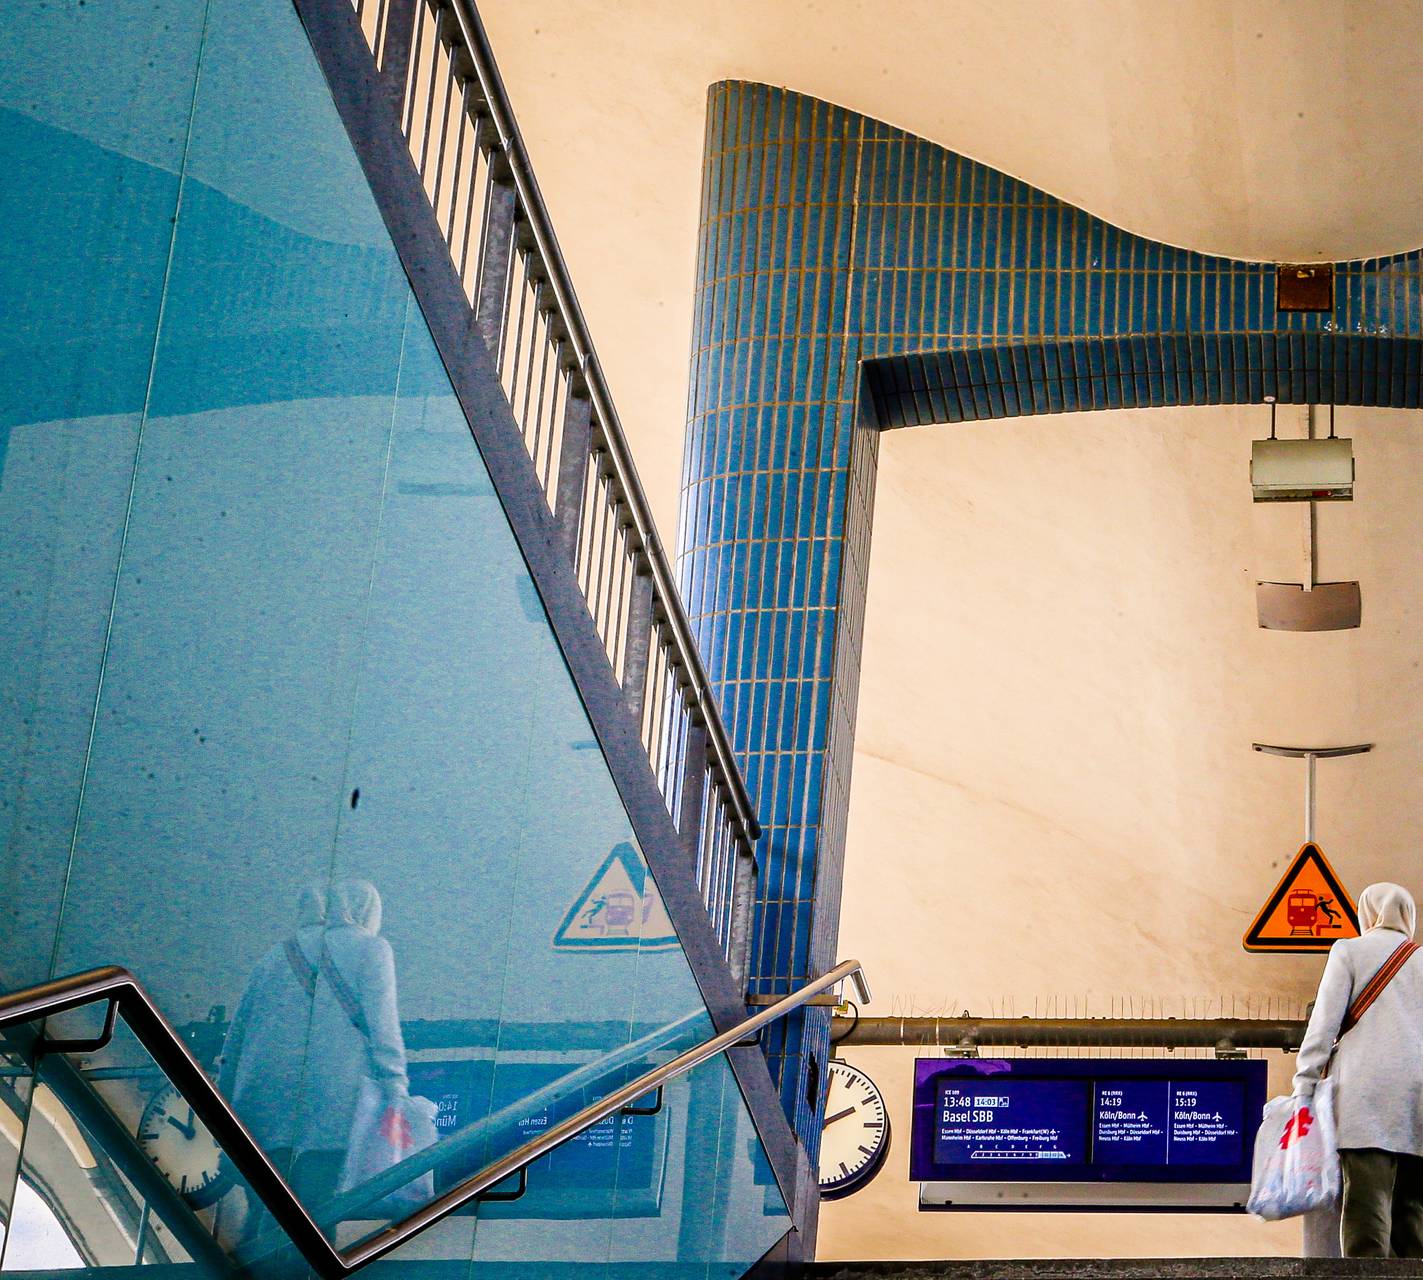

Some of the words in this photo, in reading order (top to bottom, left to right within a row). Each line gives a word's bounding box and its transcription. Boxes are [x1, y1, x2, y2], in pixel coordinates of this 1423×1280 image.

[944, 1096, 971, 1108] 13:48
[976, 1098, 996, 1106] 14:03
[1100, 1097, 1122, 1107] 14:19
[1175, 1098, 1197, 1107] 15:19
[943, 1110, 970, 1123] Basel
[972, 1110, 994, 1123] SBB
[1099, 1110, 1136, 1121] Köln/Bonn
[1174, 1111, 1211, 1121] Köln/Bonn
